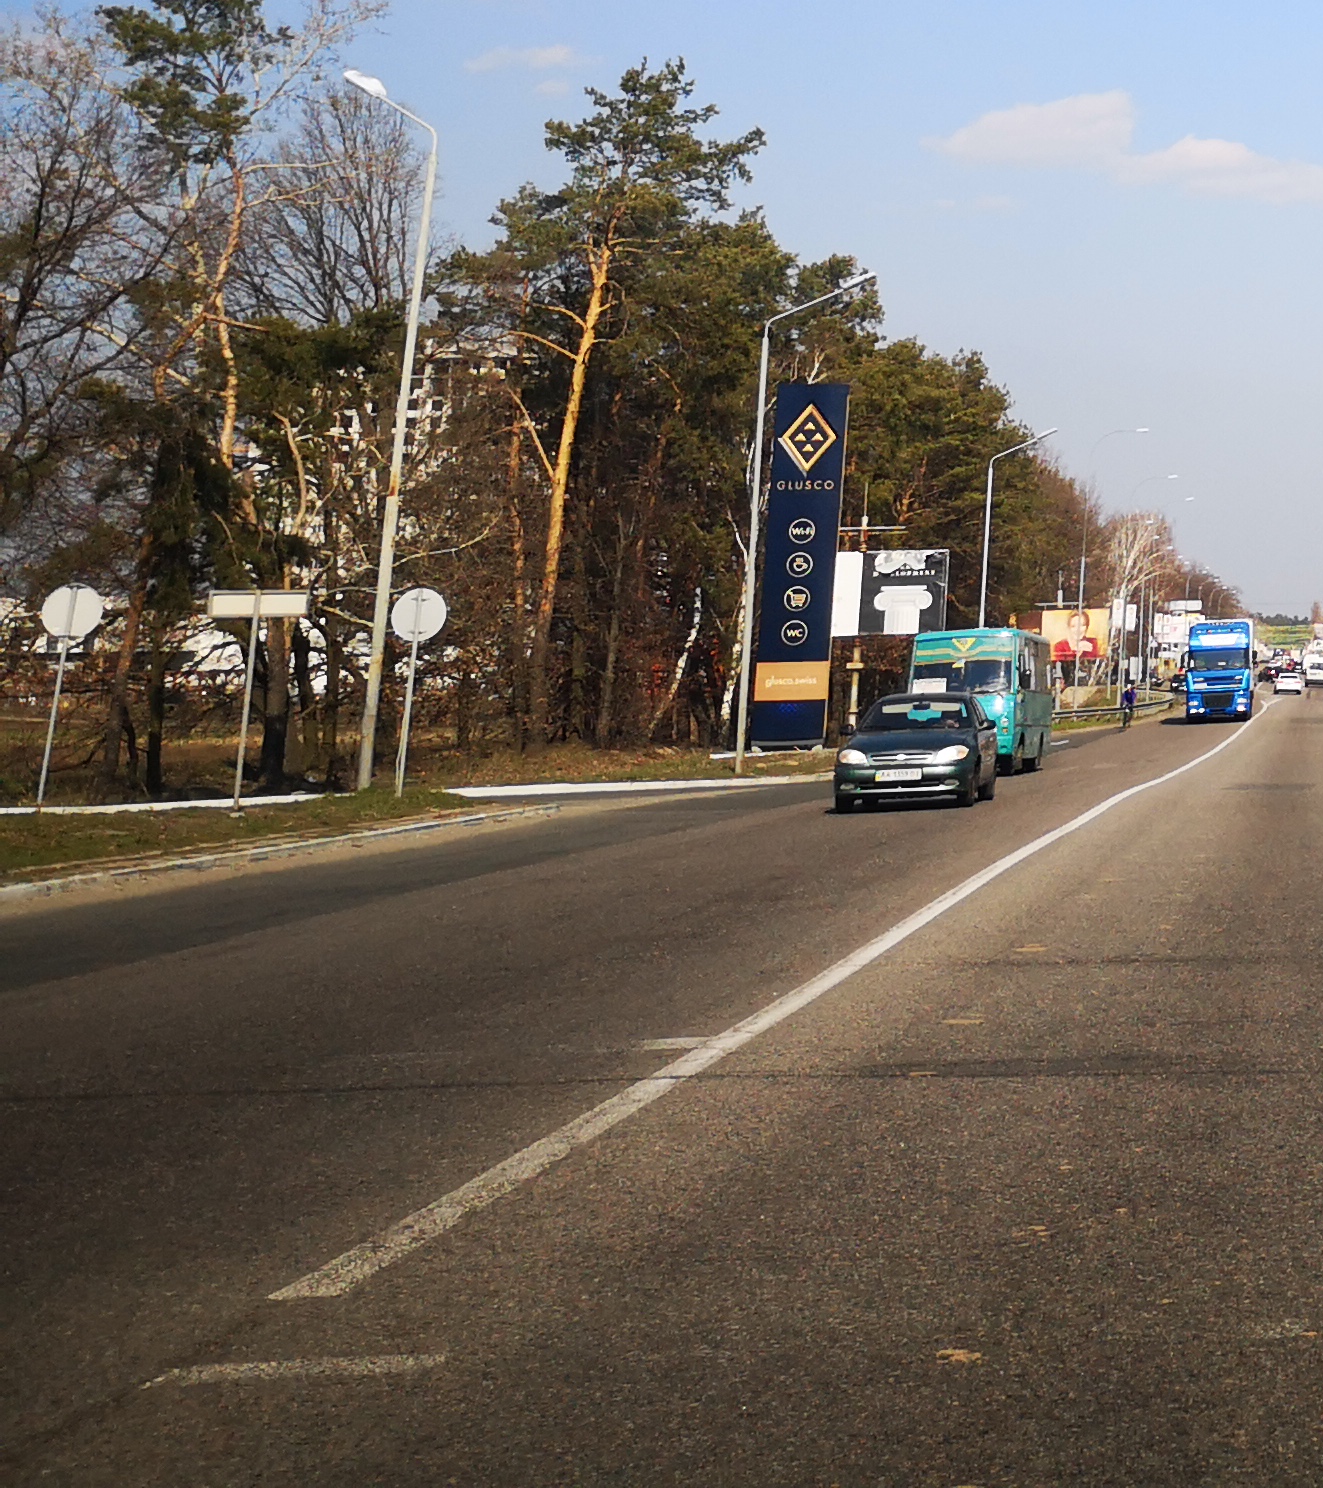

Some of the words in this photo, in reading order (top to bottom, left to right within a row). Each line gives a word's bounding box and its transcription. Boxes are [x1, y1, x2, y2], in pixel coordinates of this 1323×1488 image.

[776, 480, 835, 491] GLUSCO
[786, 628, 804, 638] WC
[765, 676, 818, 688] glusco.swiss
